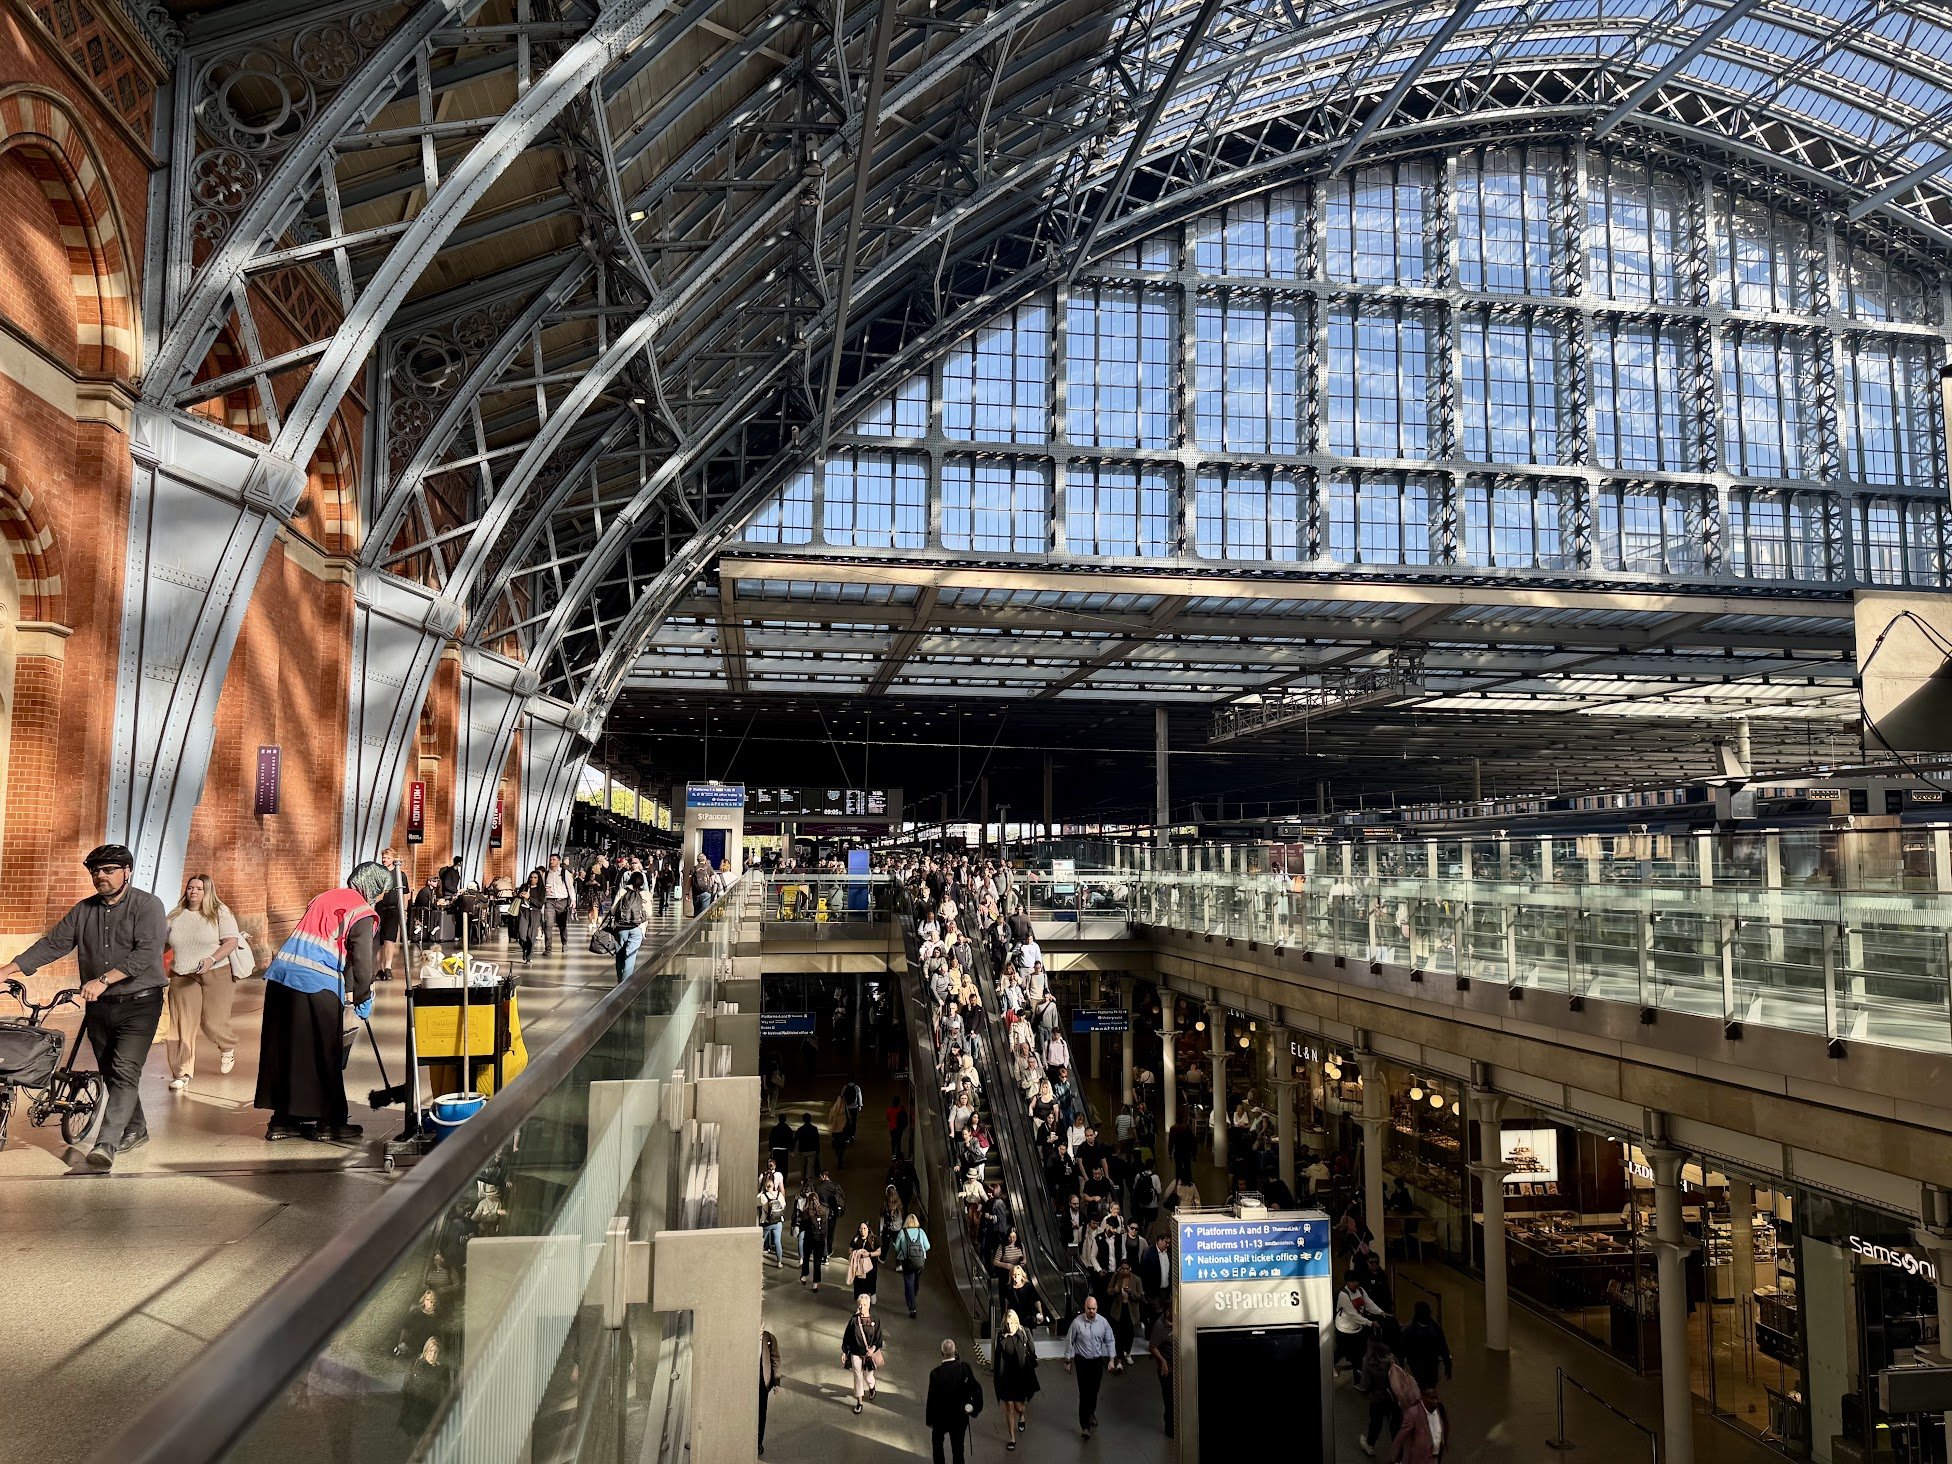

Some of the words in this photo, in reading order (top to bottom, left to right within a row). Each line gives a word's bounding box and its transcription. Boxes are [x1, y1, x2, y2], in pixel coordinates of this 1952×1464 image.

[1290, 1041, 1320, 1063] EL&N
[1197, 1227, 1238, 1237] Platforms
[1239, 1226, 1246, 1235] A
[1246, 1225, 1262, 1235] and
[1263, 1225, 1270, 1234] B
[1197, 1240, 1238, 1250] Platforms
[1239, 1239, 1263, 1248] 11-13
[1197, 1254, 1232, 1265] National
[1233, 1253, 1250, 1263] Rail
[1251, 1252, 1274, 1262] ticket
[1275, 1251, 1298, 1261] office
